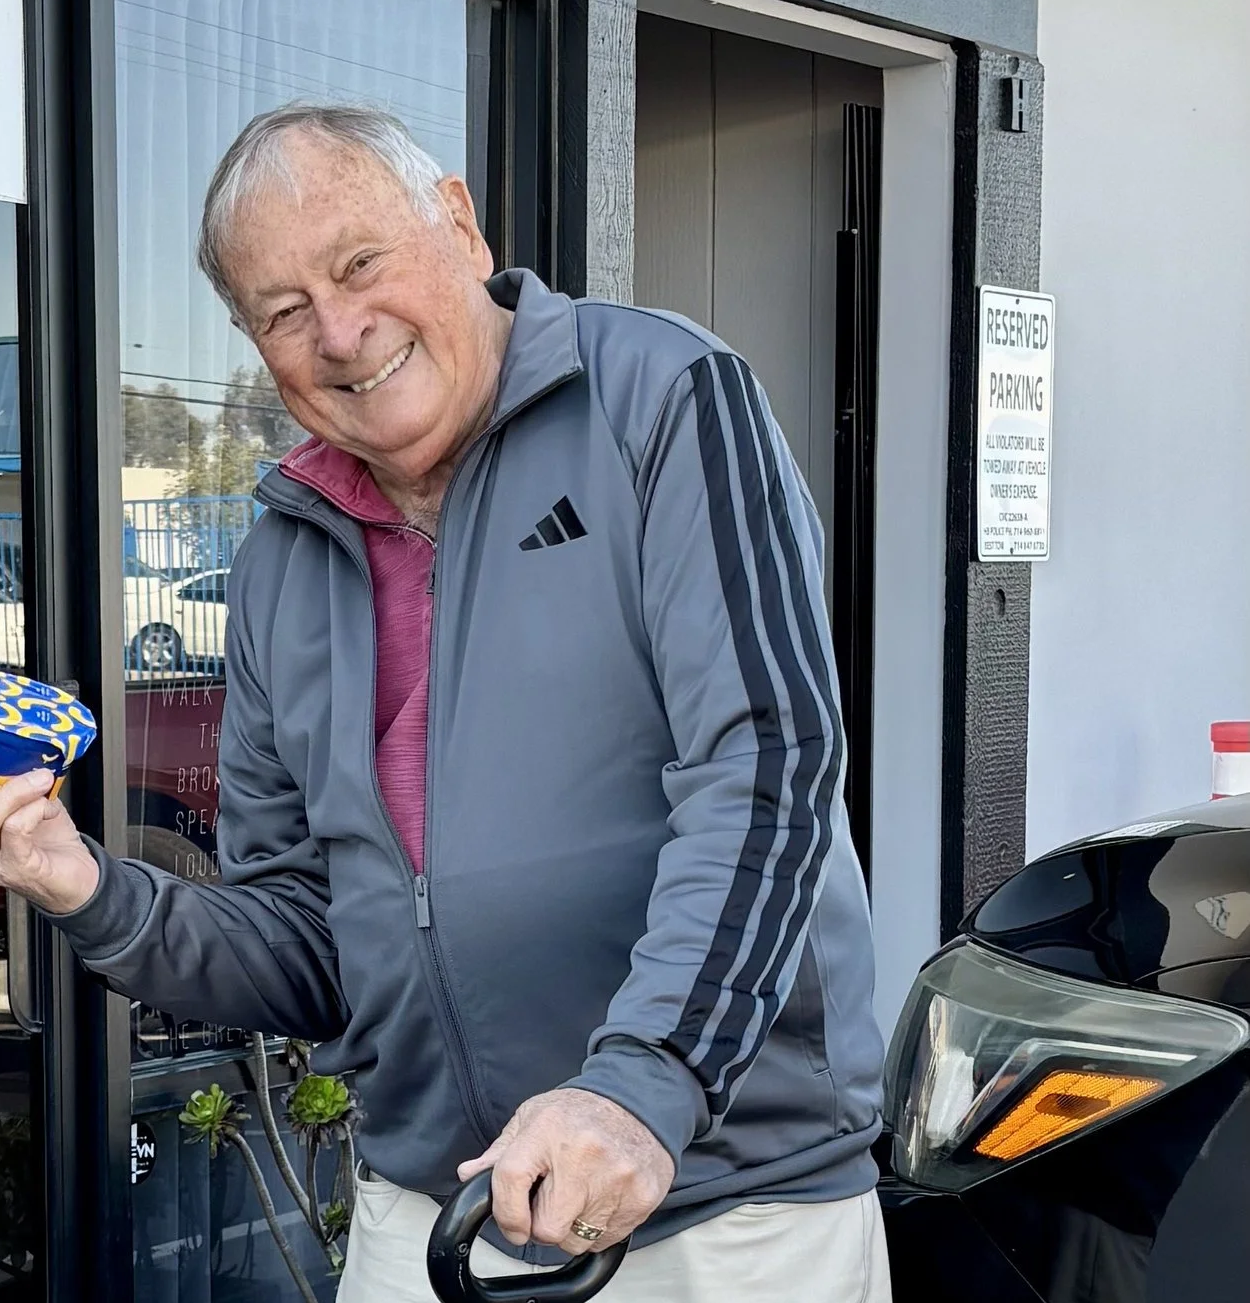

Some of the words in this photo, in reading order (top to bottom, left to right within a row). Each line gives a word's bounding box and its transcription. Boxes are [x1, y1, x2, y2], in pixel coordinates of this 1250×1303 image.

[986, 307, 1049, 351] RESERVED
[989, 371, 1043, 412] PARKING
[161, 679, 214, 708] WALK
